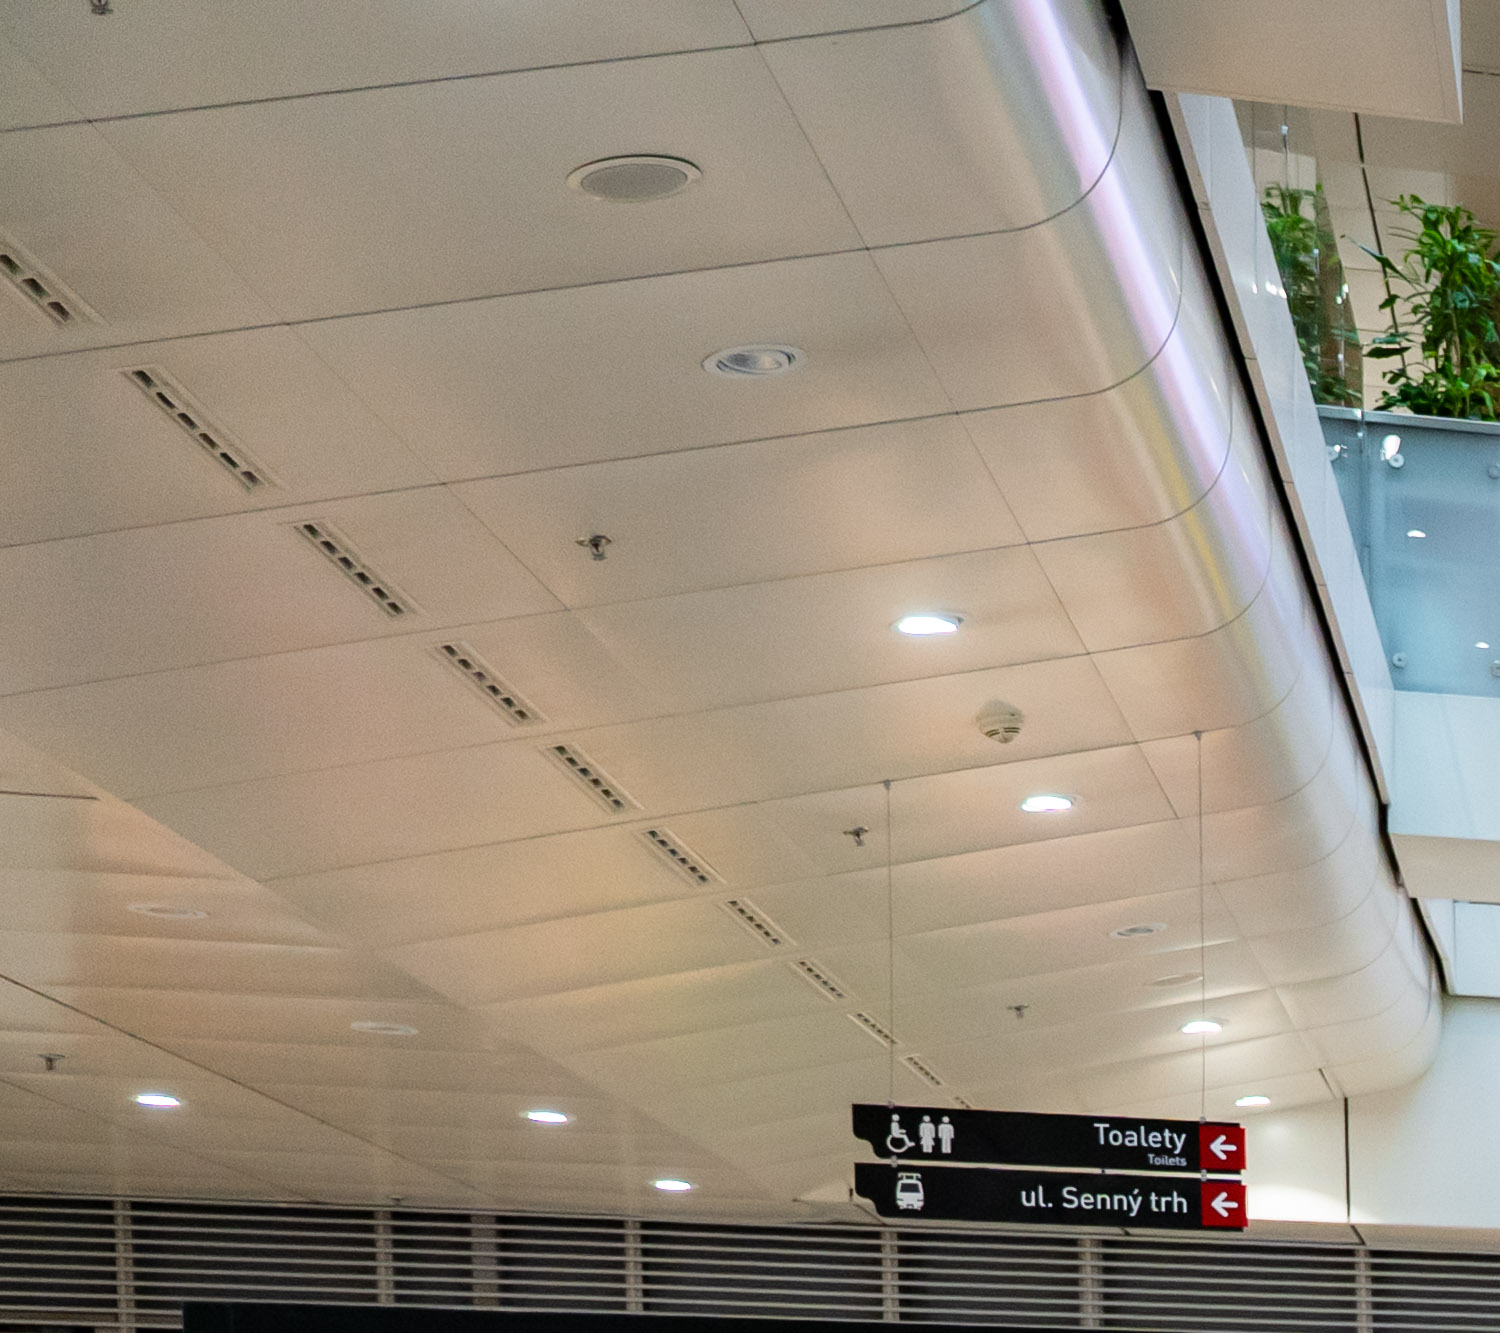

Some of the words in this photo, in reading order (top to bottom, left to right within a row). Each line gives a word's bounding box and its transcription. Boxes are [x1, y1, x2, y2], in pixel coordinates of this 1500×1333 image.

[1094, 1122, 1187, 1155] Toalety
[1148, 1153, 1187, 1166] Toilets
[1020, 1187, 1053, 1209] ul.
[1062, 1187, 1142, 1217] Senný
[1149, 1191, 1188, 1214] trh
